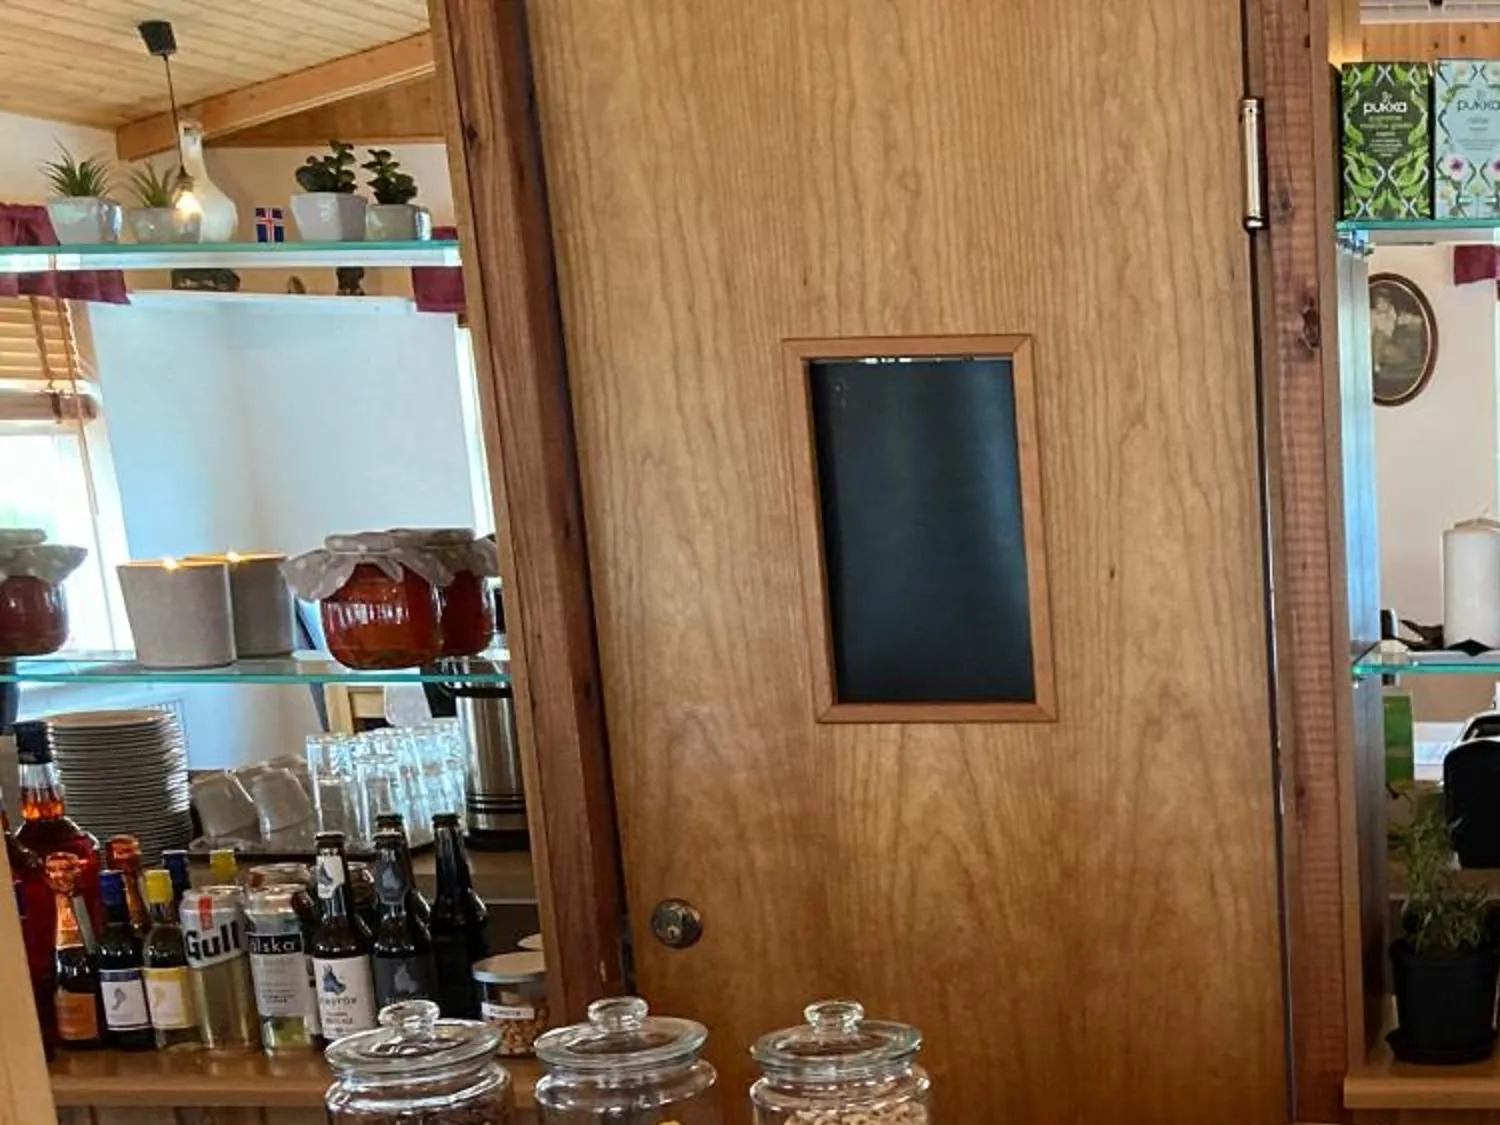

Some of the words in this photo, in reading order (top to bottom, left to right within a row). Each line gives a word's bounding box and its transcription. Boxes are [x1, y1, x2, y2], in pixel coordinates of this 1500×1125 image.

[1363, 101, 1408, 114] pukka
[1456, 99, 1500, 113] pukka
[185, 920, 240, 961] Gull
